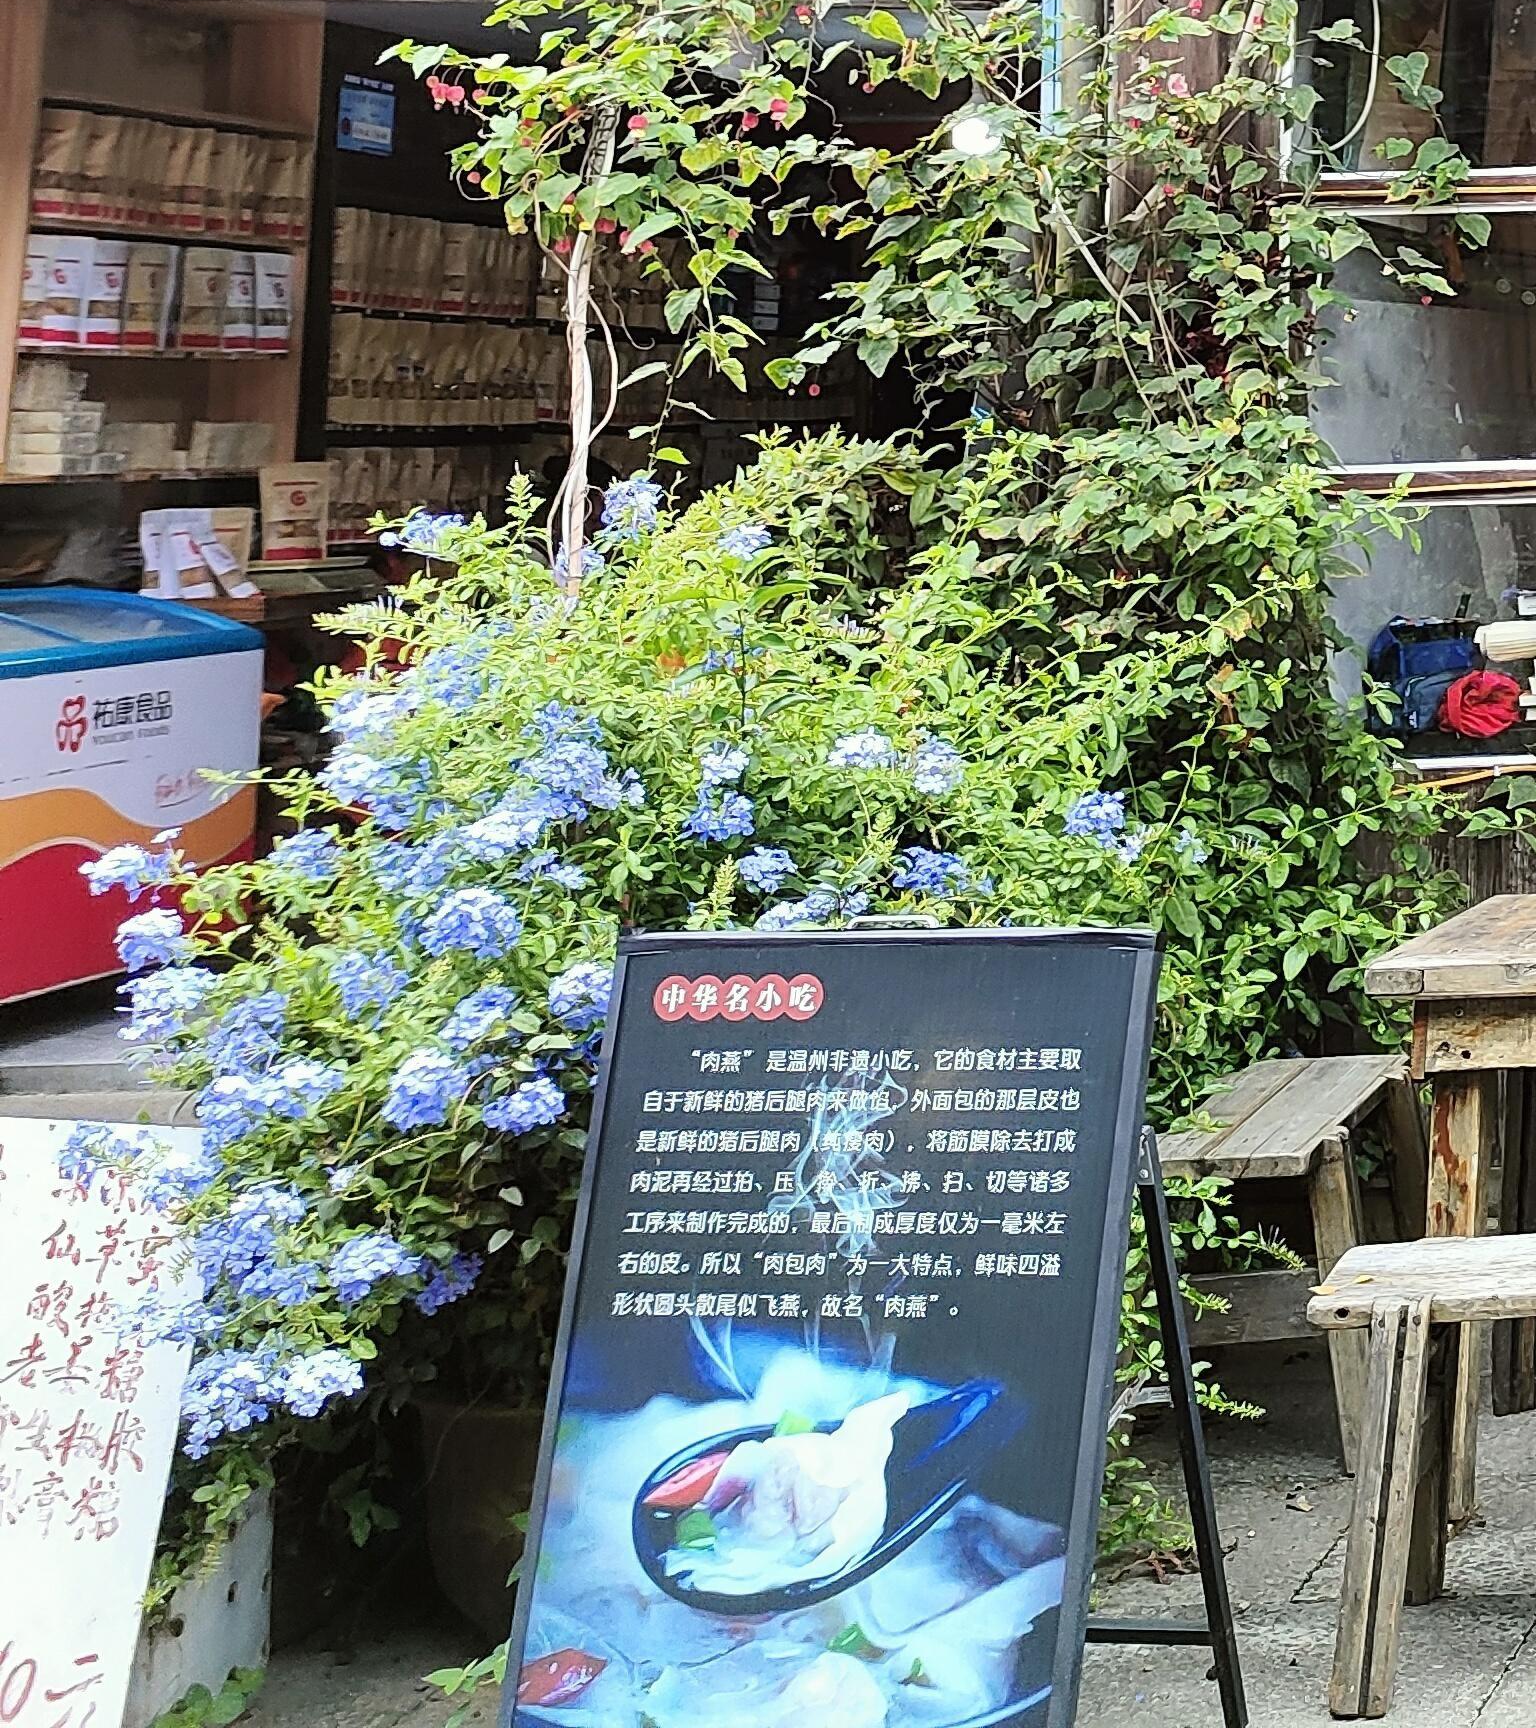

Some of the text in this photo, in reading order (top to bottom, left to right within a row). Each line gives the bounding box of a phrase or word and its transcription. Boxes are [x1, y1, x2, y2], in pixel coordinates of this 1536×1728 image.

[661, 982, 818, 1013] 中华名小吃
